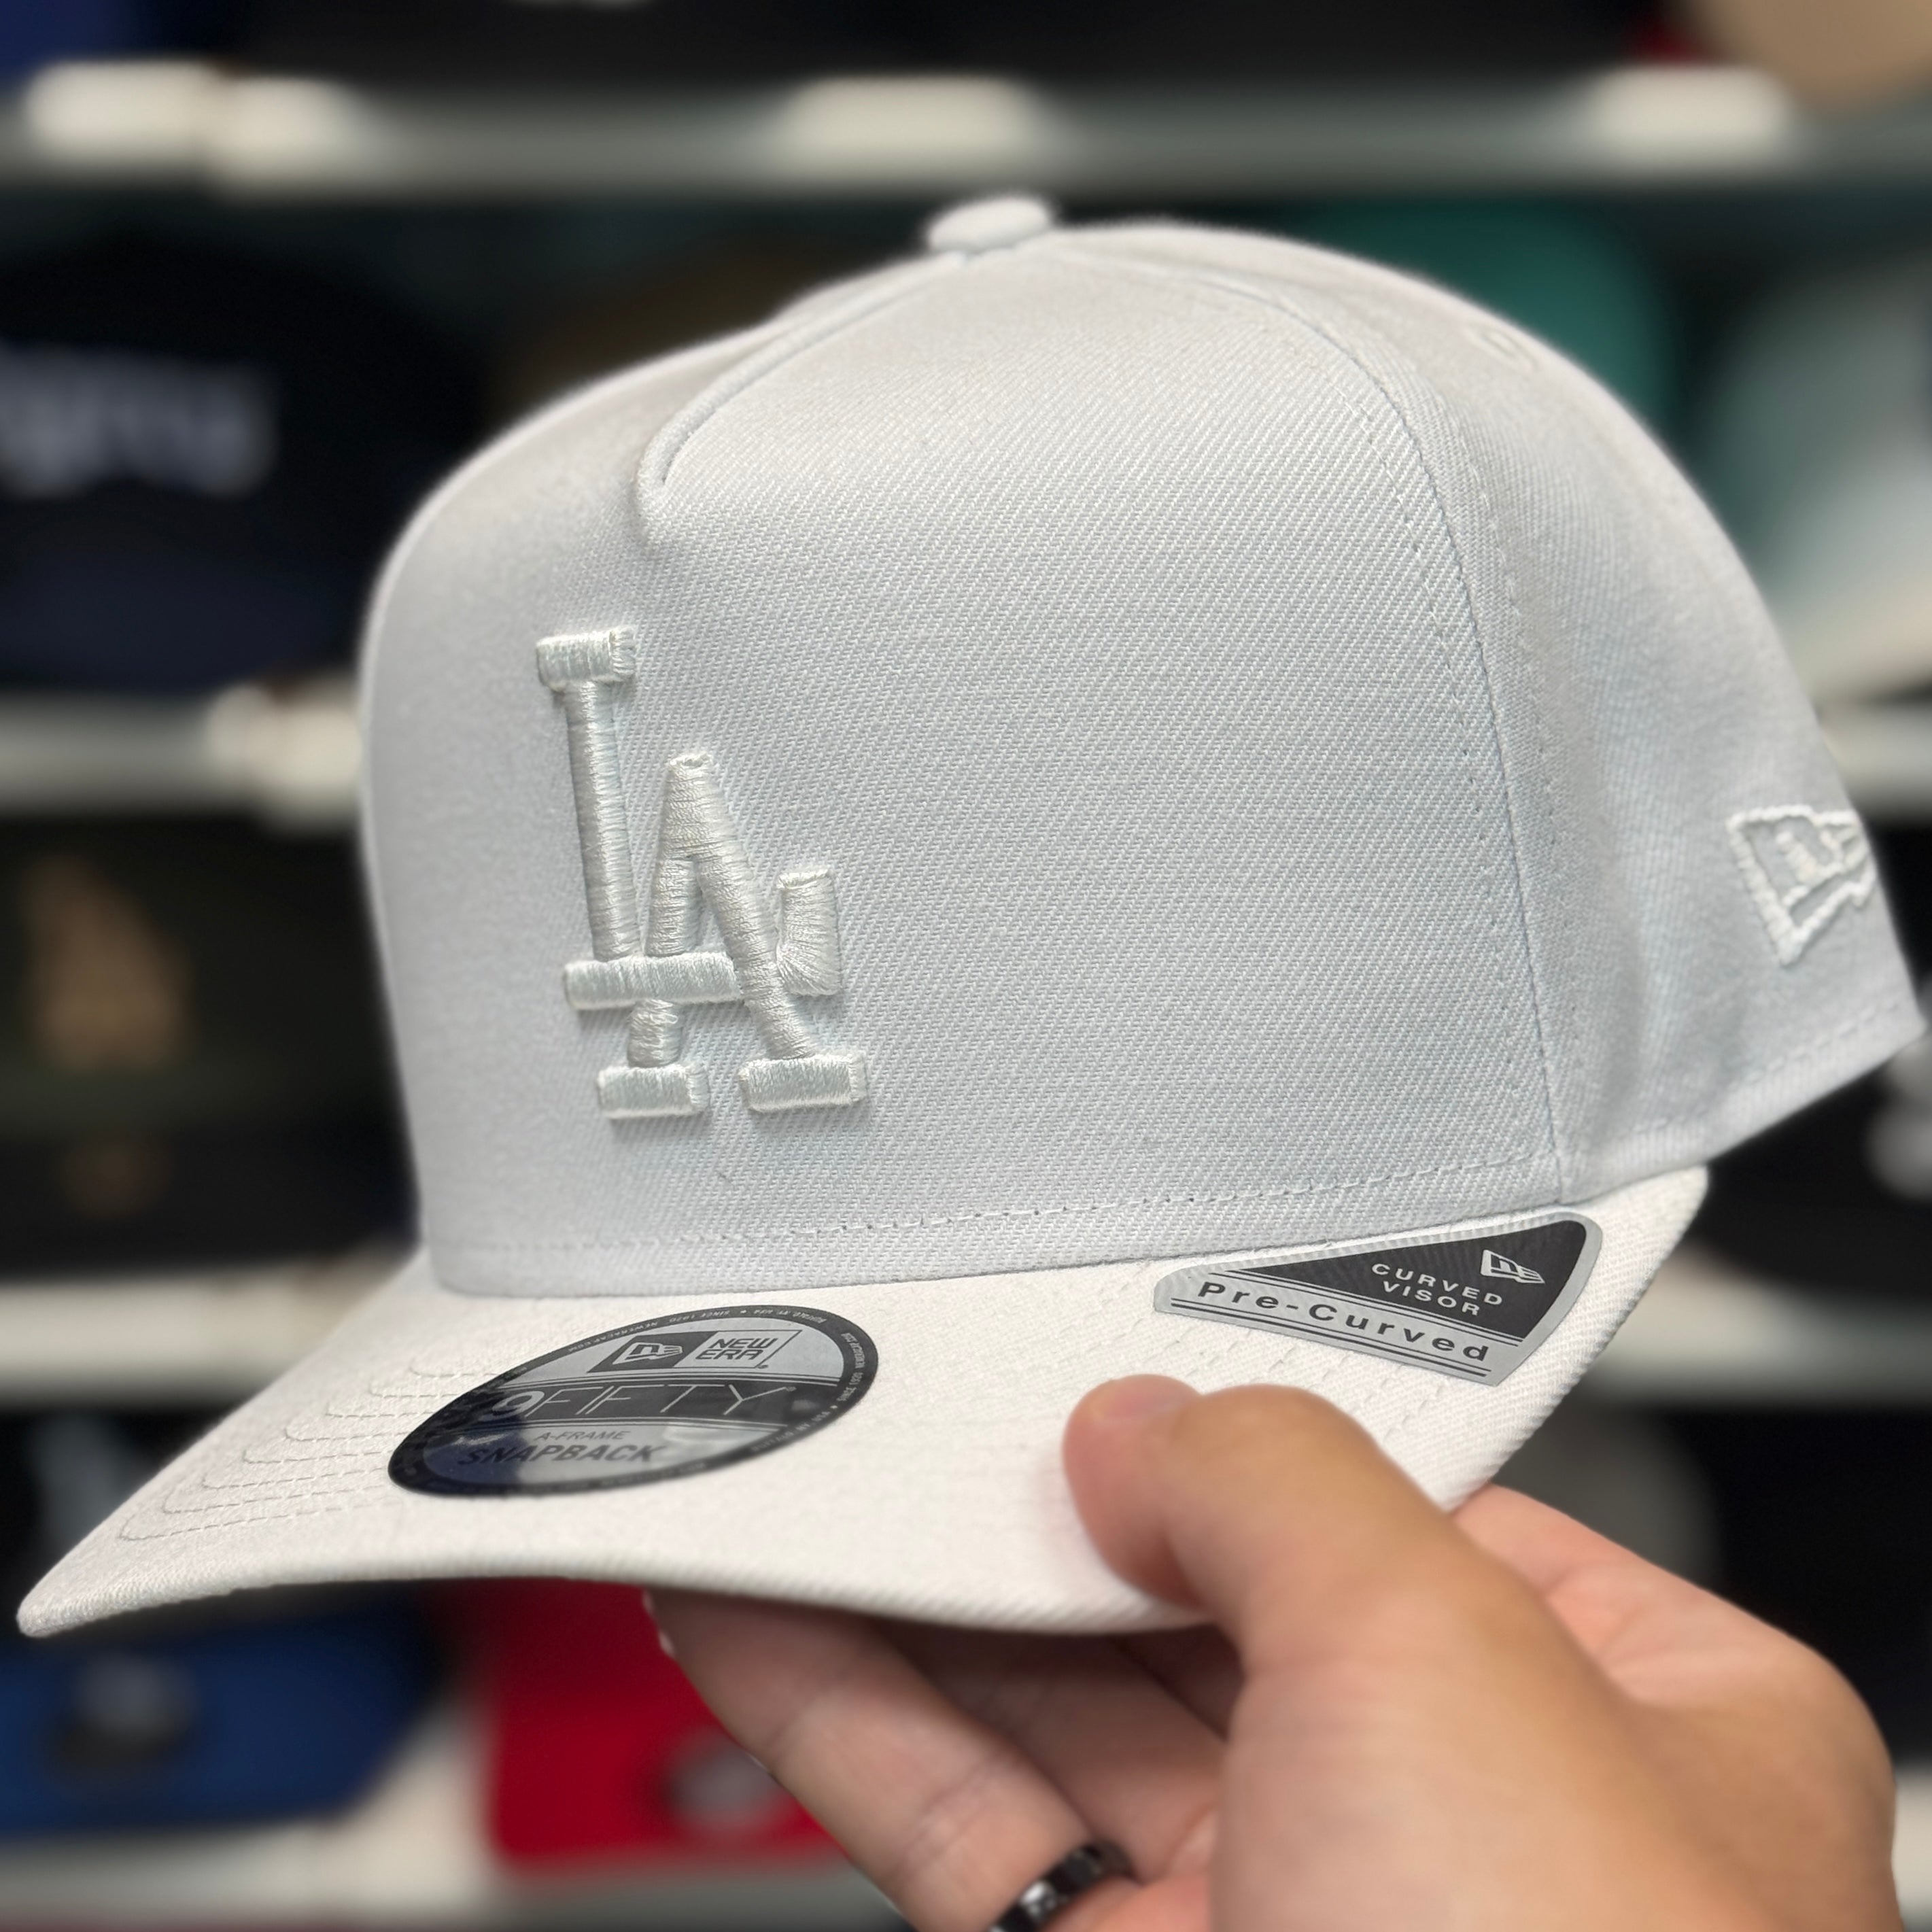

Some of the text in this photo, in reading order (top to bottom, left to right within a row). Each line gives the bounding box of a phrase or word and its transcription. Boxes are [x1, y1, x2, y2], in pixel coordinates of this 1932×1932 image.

[536, 627, 869, 1118] LA
[1371, 1262, 1503, 1306] CURVED
[1383, 1281, 1481, 1316] VISOR
[1198, 1281, 1490, 1362] Pre-Curved
[695, 1349, 764, 1360] ERA
[708, 1338, 779, 1349] NEW
[534, 1430, 631, 1442] A-FRAME
[457, 1444, 670, 1465] SNAPBACK
